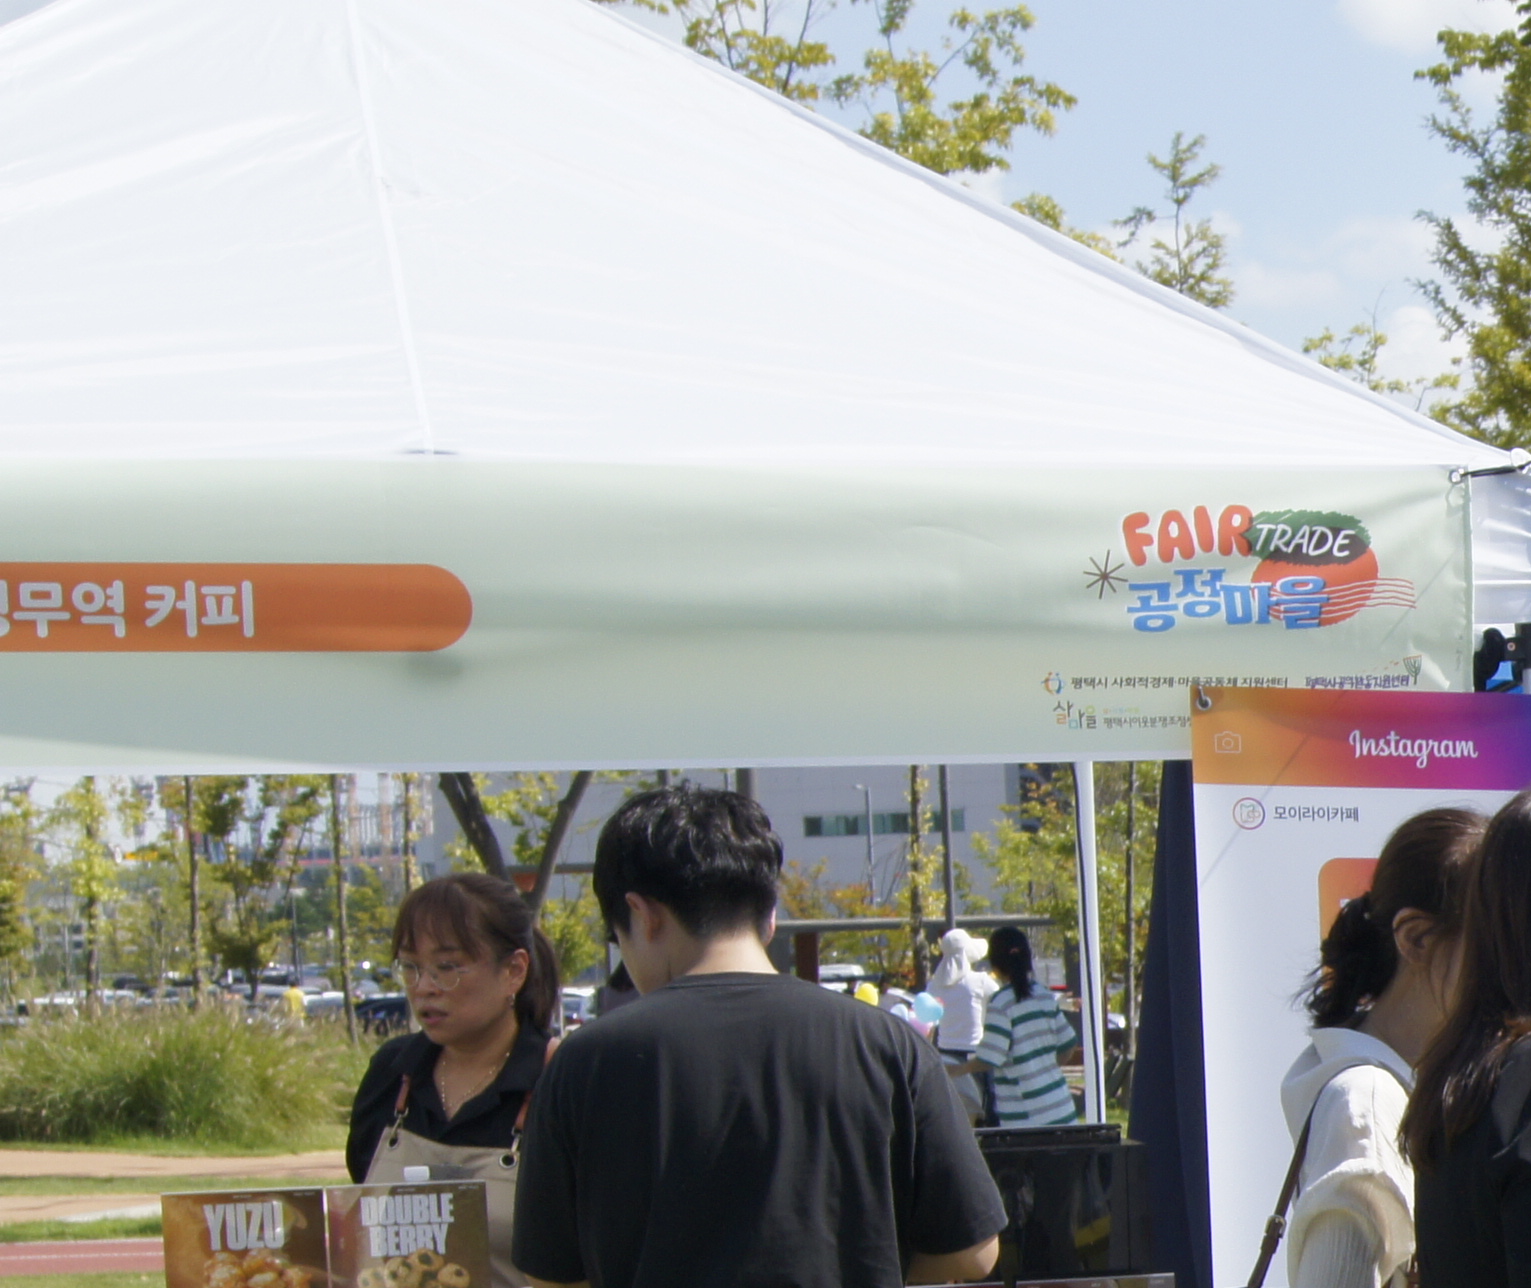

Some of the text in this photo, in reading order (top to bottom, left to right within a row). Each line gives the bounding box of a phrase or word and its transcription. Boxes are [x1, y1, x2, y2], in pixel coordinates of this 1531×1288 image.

[1122, 505, 1356, 567] FAIR TRADE
[0, 580, 255, 638] 무역 커피
[1127, 568, 1329, 633] 공정마을
[1071, 676, 1109, 689] 평택시
[1103, 715, 1193, 729] 평택시이웃분쟁조정
[1349, 729, 1479, 768] Instagram
[1273, 805, 1360, 823] 모이라이카페
[203, 1200, 285, 1251] YUZU
[360, 1193, 455, 1227] DOUBLE
[369, 1223, 449, 1257] BERRY
